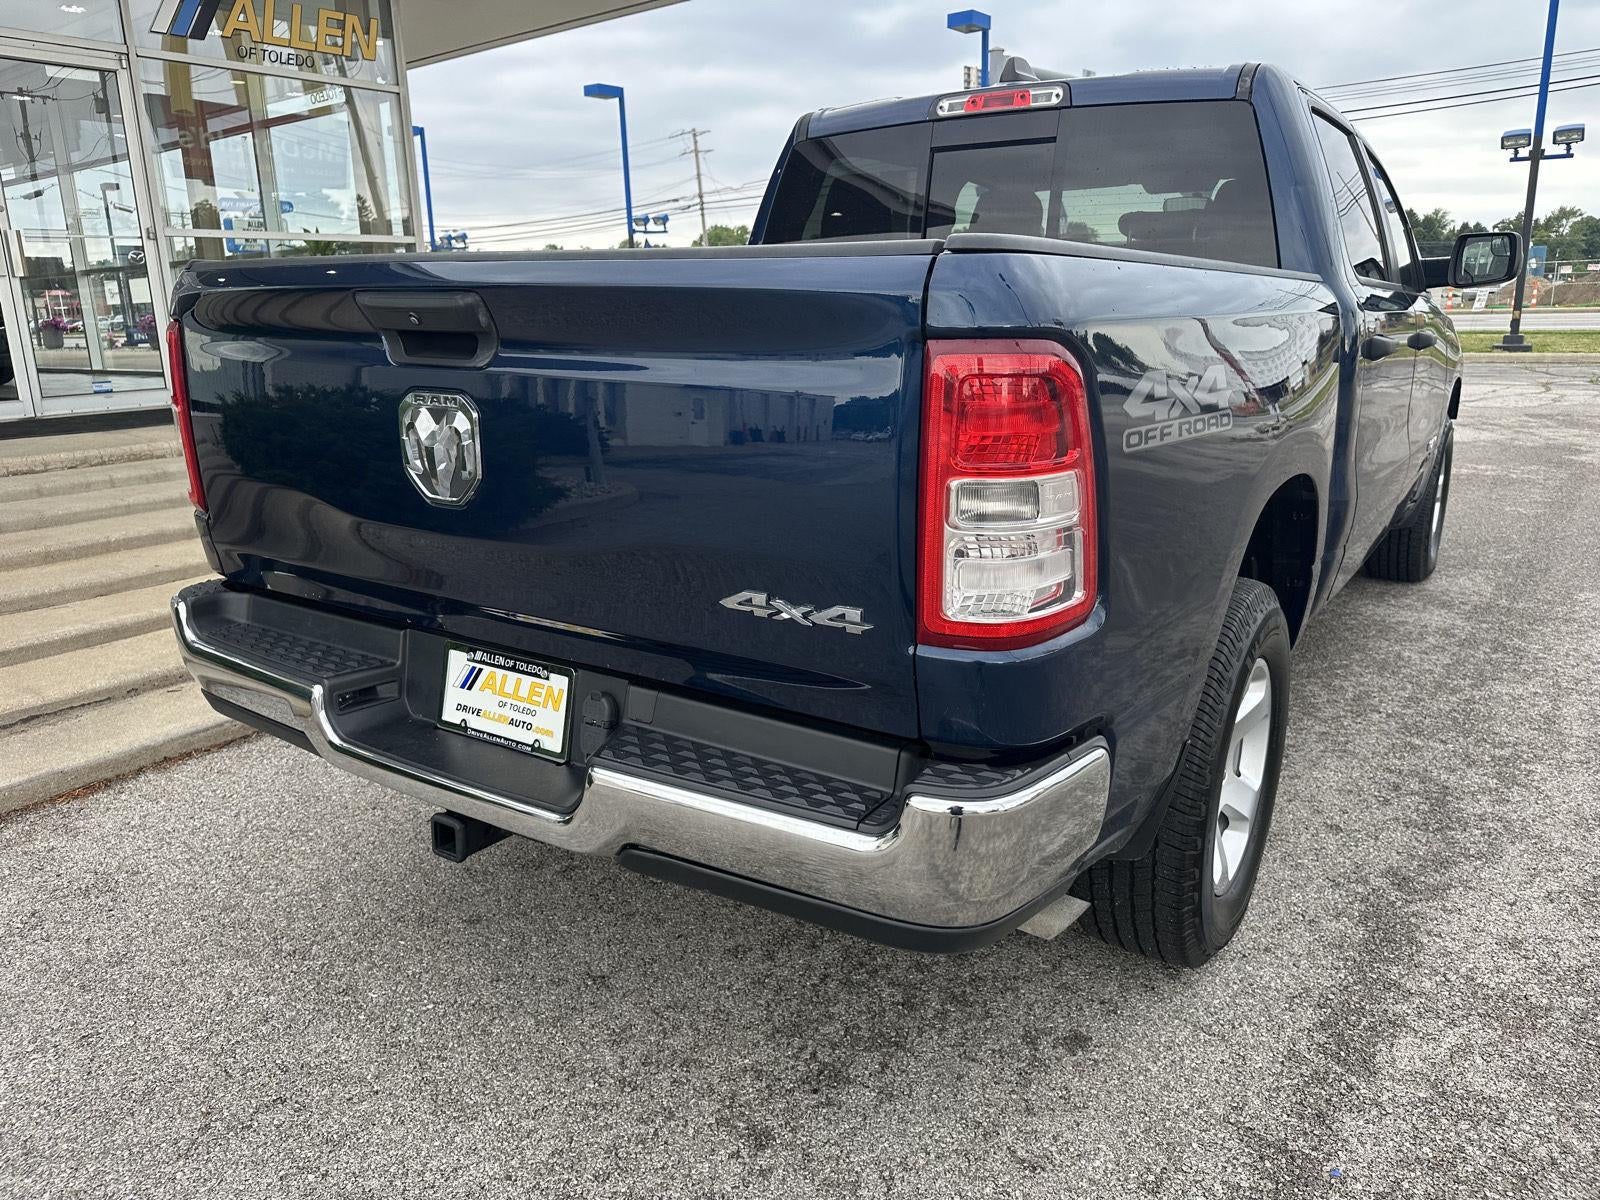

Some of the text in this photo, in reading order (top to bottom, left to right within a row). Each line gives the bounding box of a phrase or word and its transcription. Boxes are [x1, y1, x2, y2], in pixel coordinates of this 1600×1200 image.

[221, 0, 378, 62] ALLEN
[238, 45, 315, 69] OF TOLEDO
[412, 393, 460, 407] RAM
[1125, 412, 1231, 449] OFF ROAD
[481, 652, 505, 666] ALLEN
[515, 661, 542, 675] TOLEDO
[479, 670, 564, 712] ALLEN
[498, 700, 537, 717] OF TOLEDO
